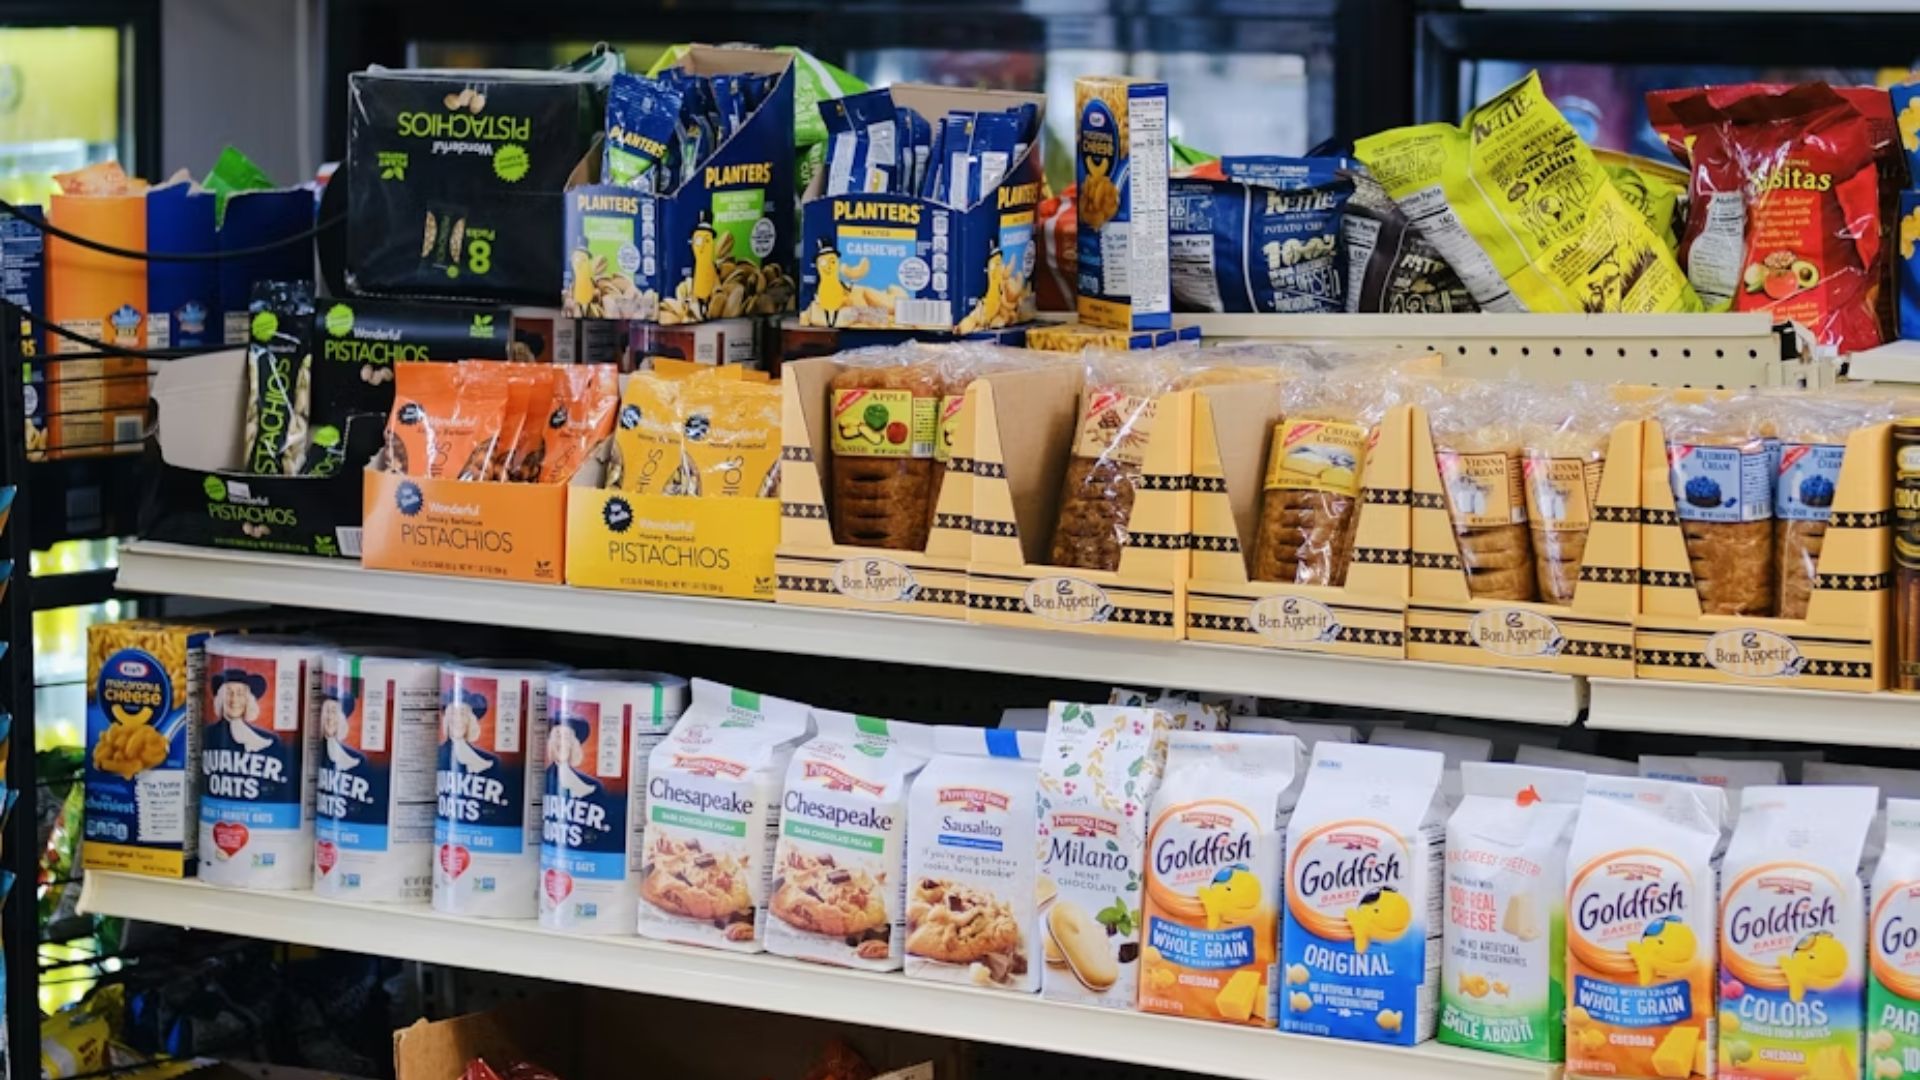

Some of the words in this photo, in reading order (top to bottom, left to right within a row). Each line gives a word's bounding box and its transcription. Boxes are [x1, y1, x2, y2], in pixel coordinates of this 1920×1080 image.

[398, 112, 530, 140] PISTACHIOS
[432, 141, 493, 155] Wonderful
[609, 125, 667, 157] PLANTERS
[705, 163, 773, 188] PLANTERS
[578, 196, 638, 214] PLANTERS
[834, 201, 921, 224] PLANTERS
[467, 241, 492, 274] 8
[846, 242, 906, 257] CASHEWS
[354, 328, 402, 341] Wonderful
[325, 340, 429, 363] PISTACHIOS
[870, 392, 907, 401] APPLE
[1465, 458, 1503, 467] VIENNA
[1696, 450, 1737, 461] BLUEBERRY
[1466, 466, 1504, 476] CREAM
[1702, 461, 1731, 471] CREAM
[1547, 472, 1581, 481] CREAM
[208, 503, 296, 525] PISTACHIOS
[428, 502, 479, 515] Wonderful
[639, 519, 695, 532] Wonderful
[401, 524, 512, 553] PISTACHIOS
[608, 541, 730, 570] PISTACHIOS
[843, 576, 864, 590] Bon
[866, 576, 908, 596] Appetit
[1033, 596, 1057, 609] Bon
[1058, 594, 1100, 611] Appetit
[1259, 613, 1282, 628] Bon
[1284, 613, 1327, 631] Appetit
[1481, 628, 1504, 642] Bon
[1507, 628, 1552, 647] Appetit
[1716, 648, 1740, 663] Bon
[1743, 648, 1791, 664] Appetit
[106, 679, 154, 691] macaroni
[210, 774, 259, 799] OATS
[650, 777, 753, 814] Chesapeake
[438, 795, 480, 821] OATS
[785, 790, 893, 831] Chesapeake
[942, 816, 1001, 837] Sausalito
[851, 838, 873, 849] PECAN
[1045, 837, 1129, 871] Milano
[1156, 832, 1252, 875] Goldfish
[1074, 870, 1100, 881] MINT
[1175, 869, 1213, 881] BAKED
[1300, 853, 1400, 897] Goldfish
[1058, 878, 1117, 893] CHOCOLATE
[1321, 890, 1360, 904] BAKED
[1578, 882, 1685, 931] Goldfish
[1451, 906, 1497, 933] CHEESE
[1731, 896, 1836, 945] Goldfish
[1601, 922, 1643, 937] BAKED
[1153, 929, 1199, 957] WHOLE
[1205, 940, 1248, 958] GRAIN
[1753, 936, 1794, 949] BAKED
[1304, 944, 1394, 977] ORIGINAL
[1178, 974, 1220, 988] CHEDDAR
[1580, 988, 1632, 1015] WHOLE
[1636, 995, 1685, 1015] GRAIN
[1739, 994, 1829, 1027] COLORS
[1442, 1008, 1480, 1040] SMILE
[1881, 1004, 1920, 1037] PAR
[1609, 1033, 1656, 1047] CHEDDAR
[1759, 1048, 1806, 1063] CHEDDAR
